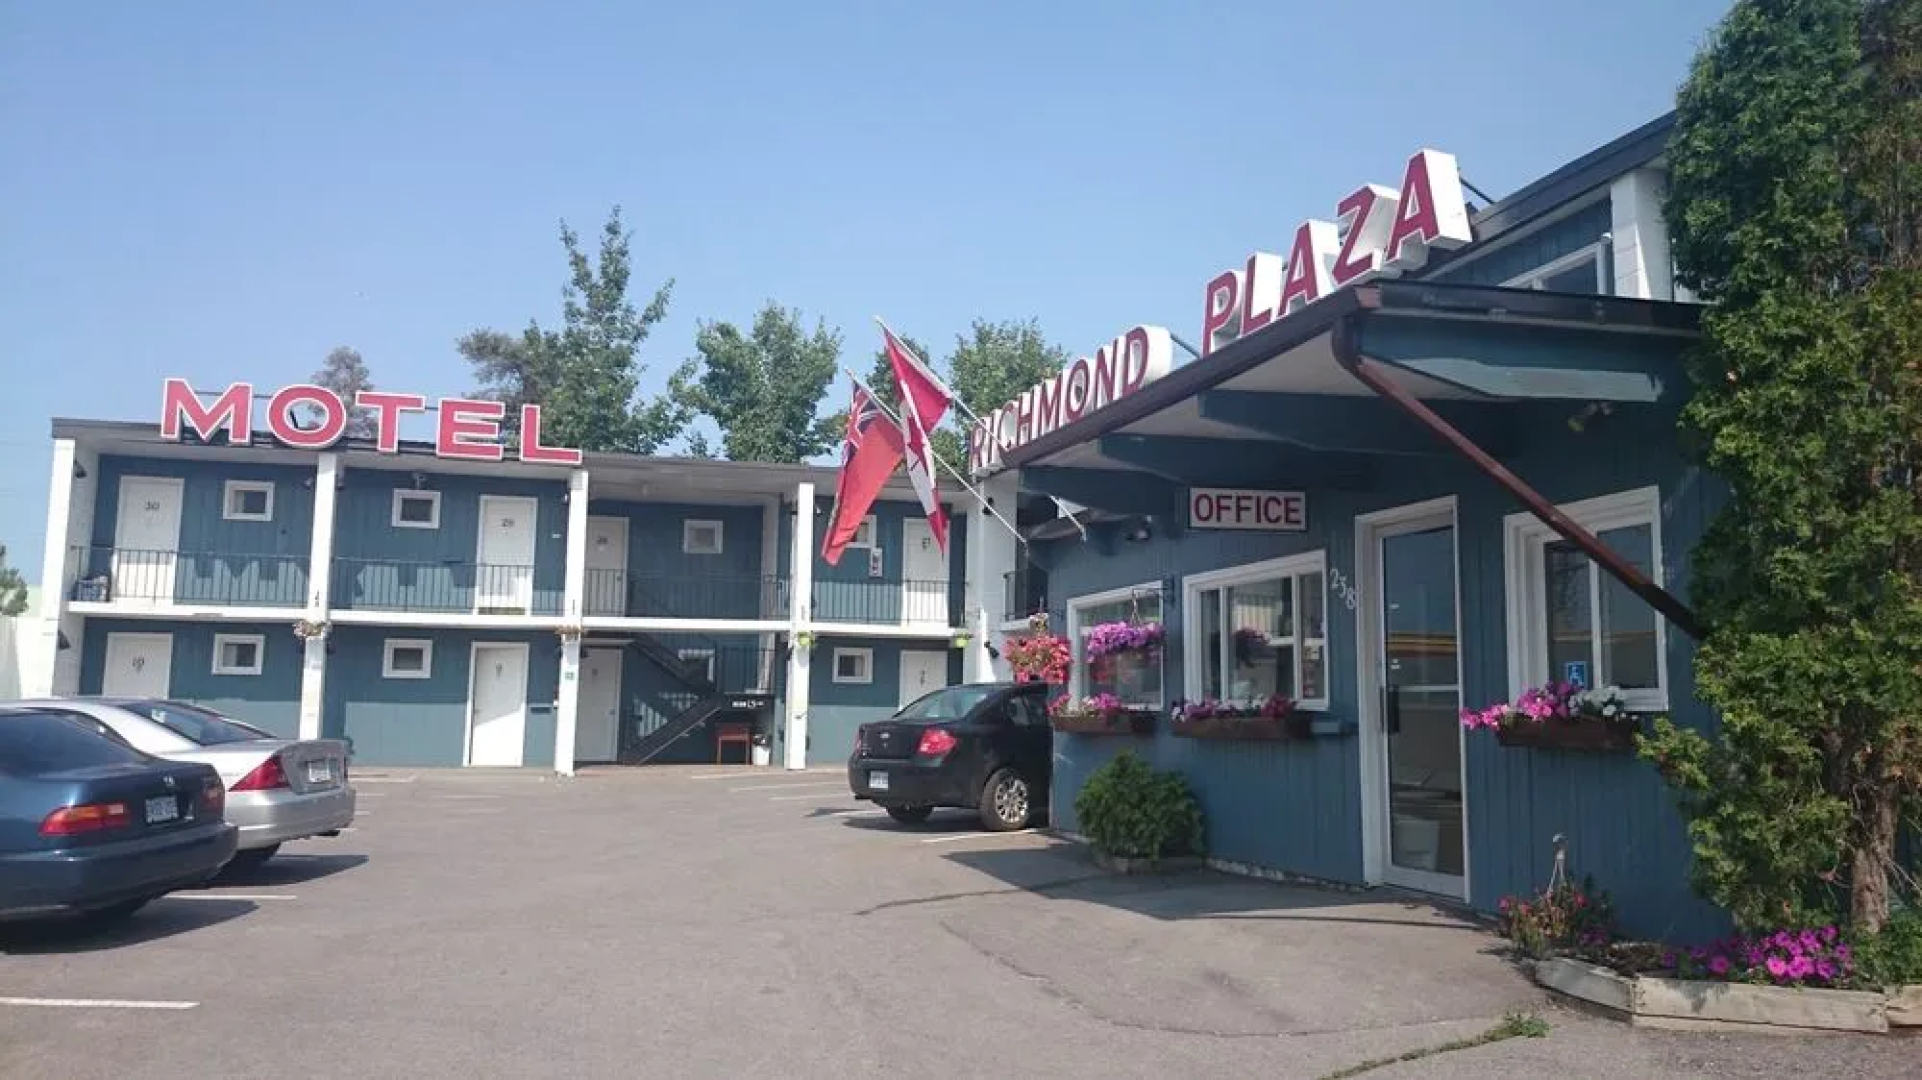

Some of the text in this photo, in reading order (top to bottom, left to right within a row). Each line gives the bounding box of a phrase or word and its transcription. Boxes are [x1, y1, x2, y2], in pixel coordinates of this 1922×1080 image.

[969, 149, 1452, 470] RICHMOND PLAZA
[160, 377, 583, 465] MOTEL
[1193, 492, 1303, 525] OFFICE
[1329, 567, 1357, 610] 238
